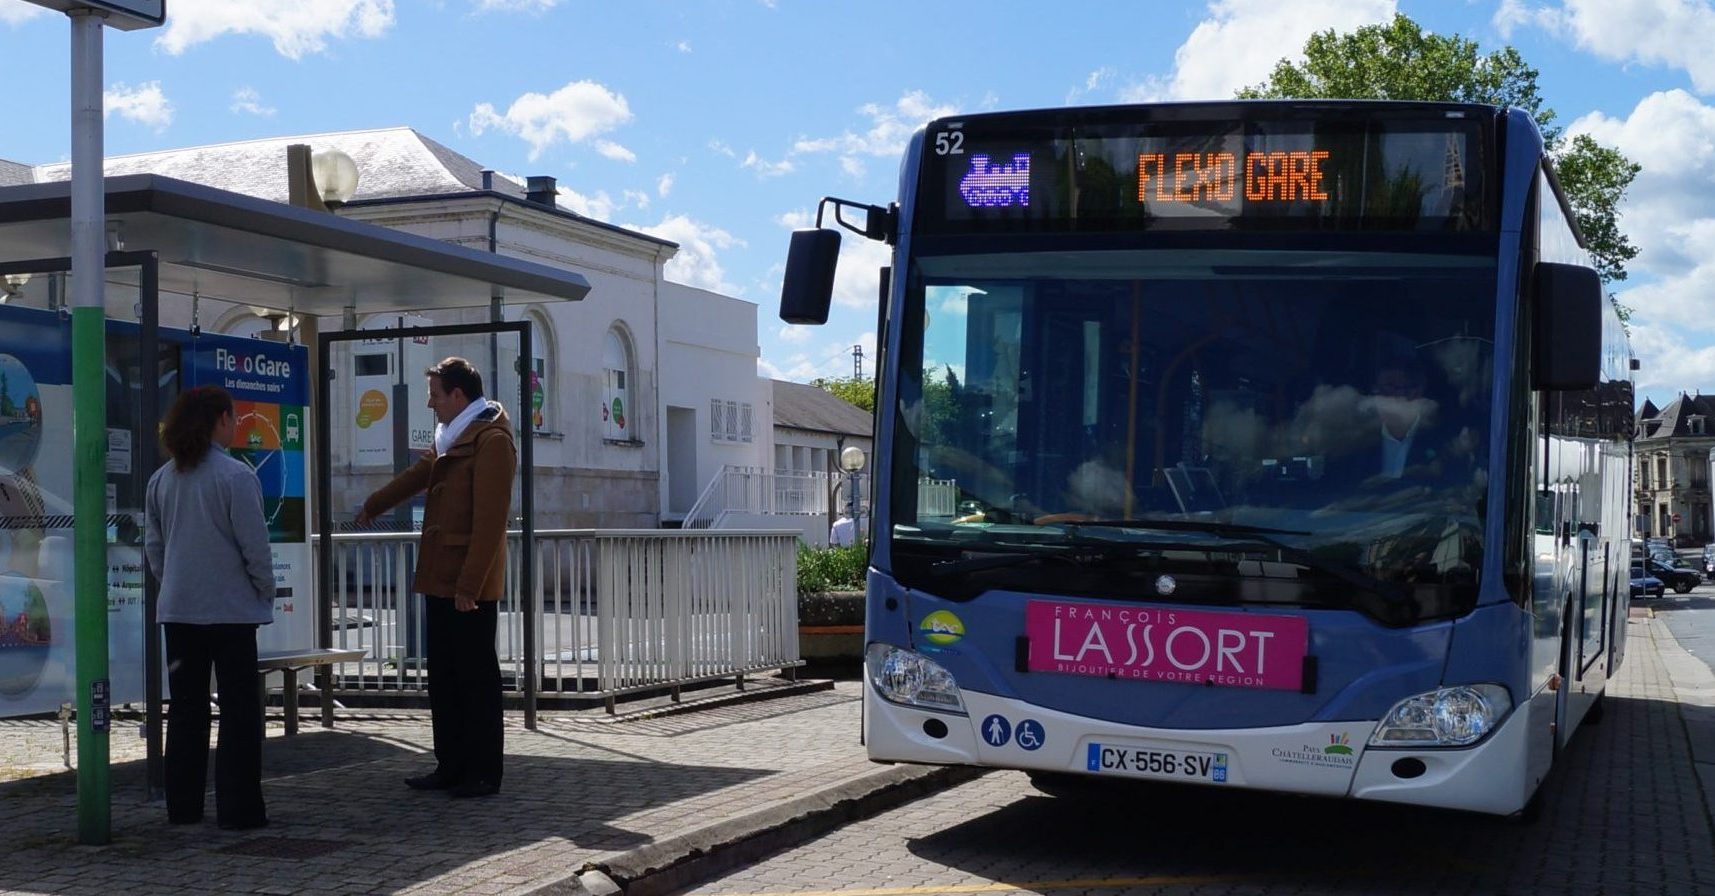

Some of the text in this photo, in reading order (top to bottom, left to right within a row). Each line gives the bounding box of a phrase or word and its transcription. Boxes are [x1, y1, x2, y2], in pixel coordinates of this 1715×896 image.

[936, 131, 964, 156] 52
[1138, 150, 1329, 202] FLEXO GARE
[255, 354, 291, 378] Gare
[225, 377, 235, 388] Les
[236, 379, 267, 392] dimanches
[412, 428, 433, 443] GARE
[1053, 618, 1275, 676] LASSORT
[1057, 664, 1125, 677] BIJOUTIER
[1133, 669, 1149, 679] DE
[1157, 672, 1202, 683] VOTRE
[1101, 748, 1211, 778] CX-556-SV
